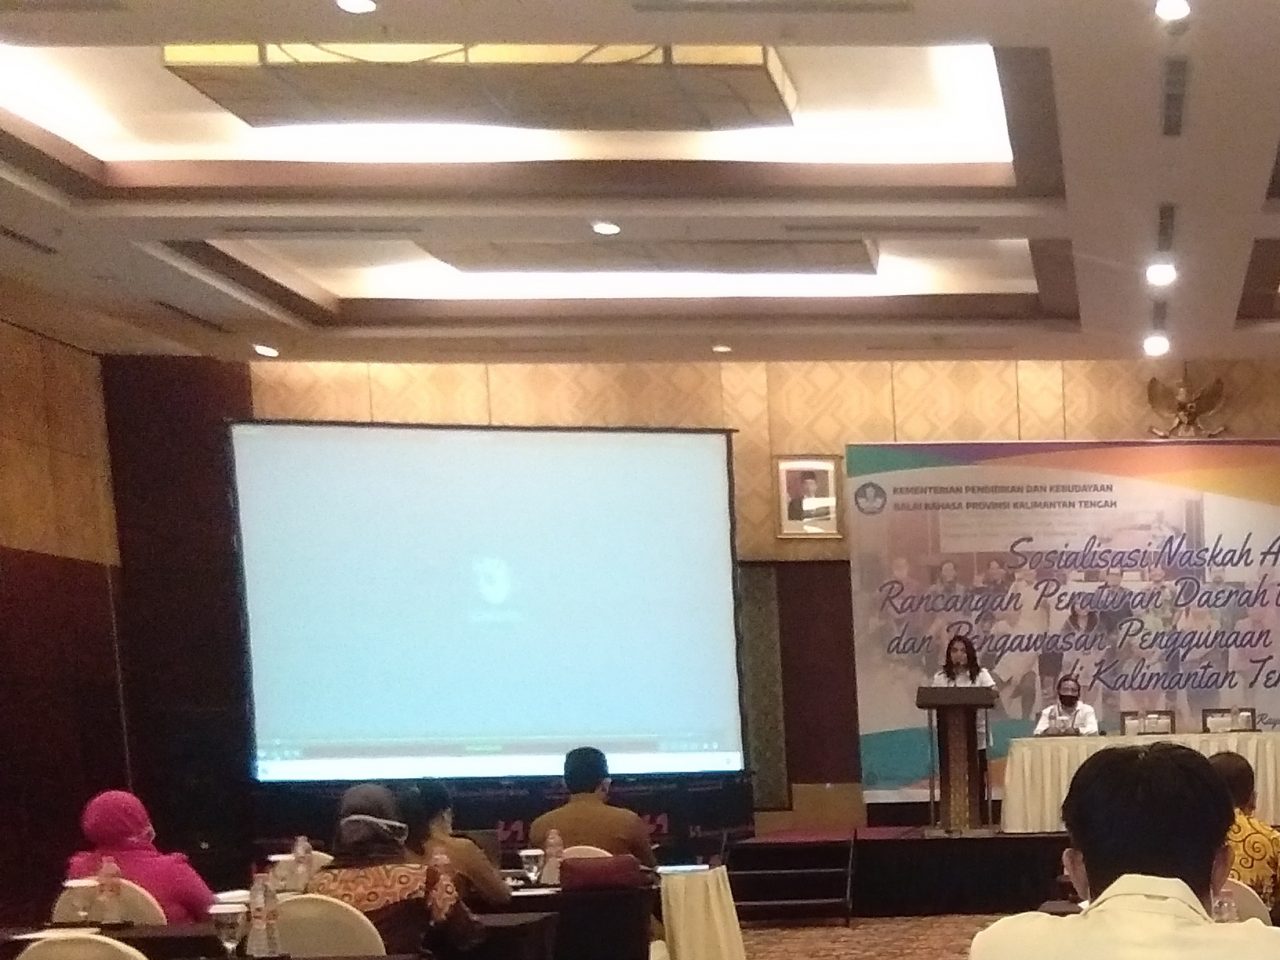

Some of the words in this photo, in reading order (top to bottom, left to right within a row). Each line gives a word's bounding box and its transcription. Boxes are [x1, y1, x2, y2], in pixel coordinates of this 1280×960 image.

[892, 486, 963, 496] KEMENTERIAN
[965, 485, 1024, 495] PENDIDIKAN
[1026, 484, 1047, 494] DAN
[1049, 484, 1113, 494] KEBUDAYAAN
[893, 502, 922, 512] BALAI
[924, 502, 963, 511] BAHASA
[966, 501, 1011, 511] PROVINSI
[1013, 500, 1076, 510] KALIMANTAN
[1078, 499, 1118, 510] TENGAH
[1008, 534, 1152, 571] Sosialisasi
[1154, 532, 1253, 570] Naskah
[879, 579, 1023, 624] Rancangan
[1033, 577, 1164, 612] Peraturan
[1174, 573, 1271, 609] Daerah
[887, 623, 933, 655] dan
[1118, 617, 1273, 662] Penggunaan
[1088, 657, 1239, 693] Kalimantan
